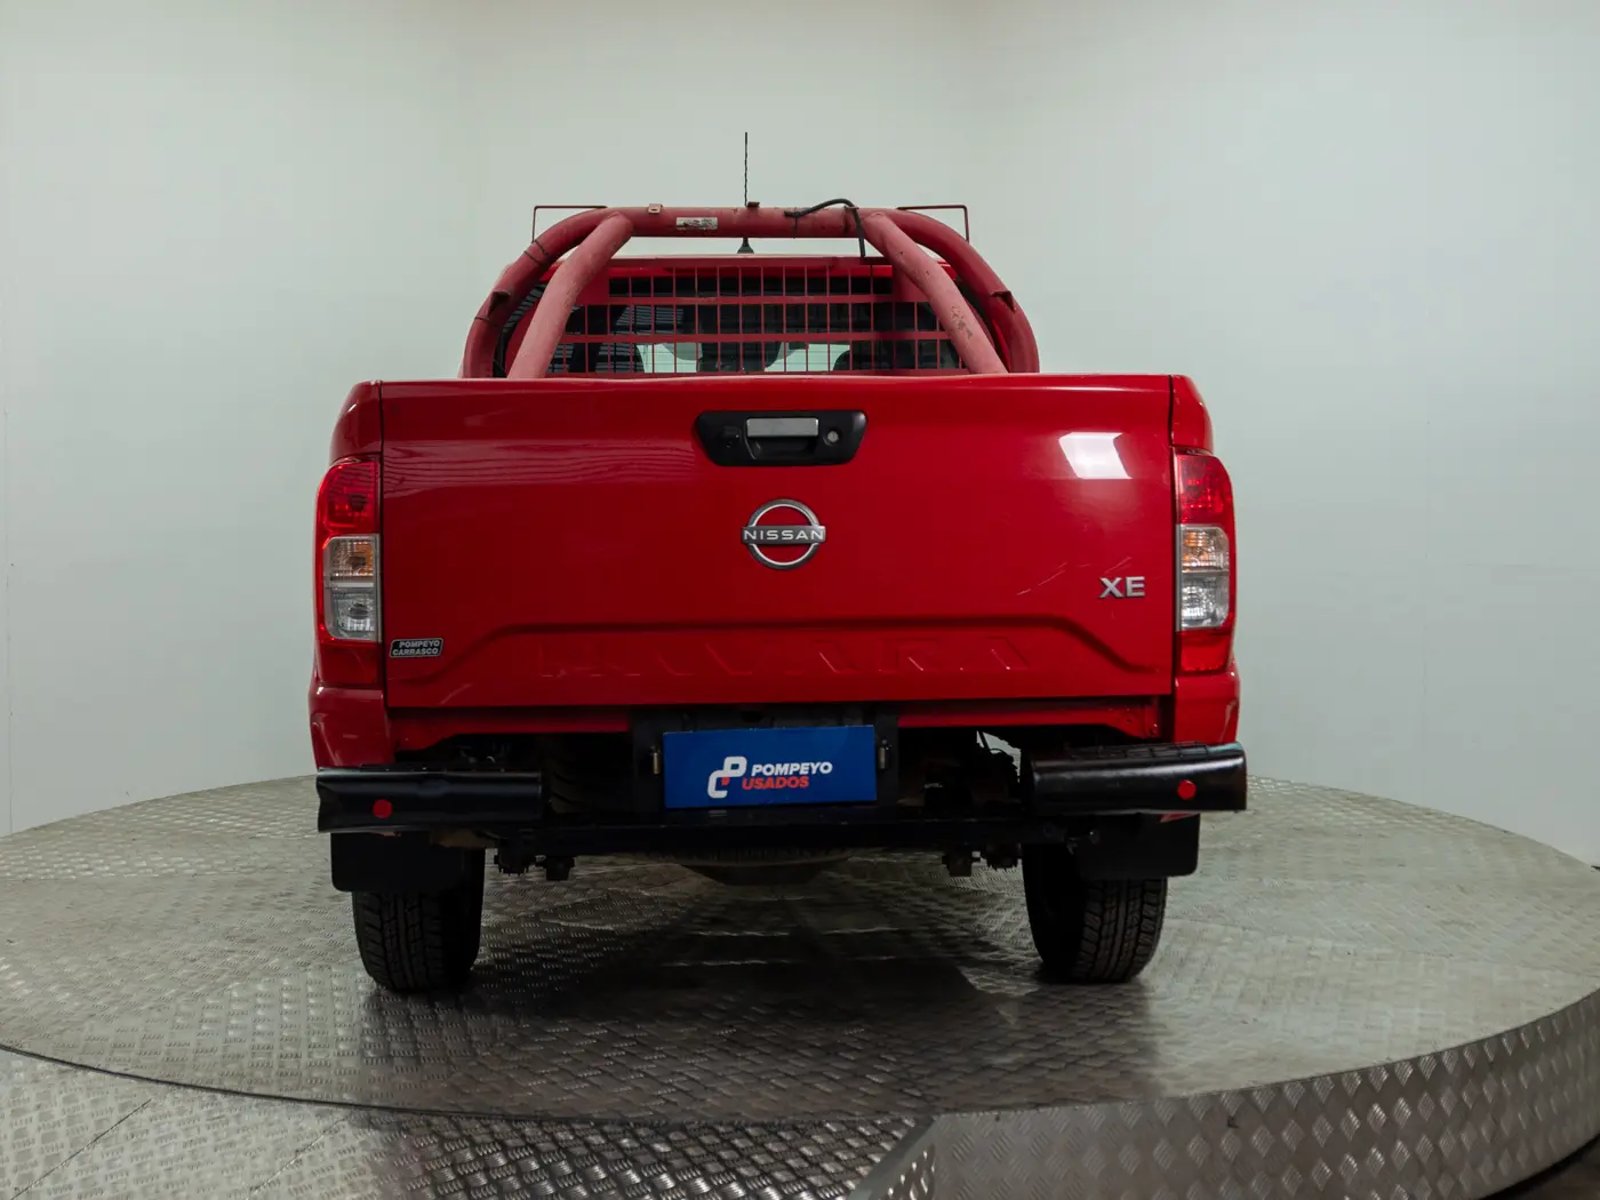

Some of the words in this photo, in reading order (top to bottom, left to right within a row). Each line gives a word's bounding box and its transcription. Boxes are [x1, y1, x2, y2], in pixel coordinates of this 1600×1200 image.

[743, 529, 824, 541] NISSAN
[1099, 576, 1146, 599] XE
[399, 640, 440, 648] POMPEYO
[392, 648, 439, 656] CARRASCO
[751, 761, 833, 777] POMPEYO
[741, 775, 810, 790] USADOS
